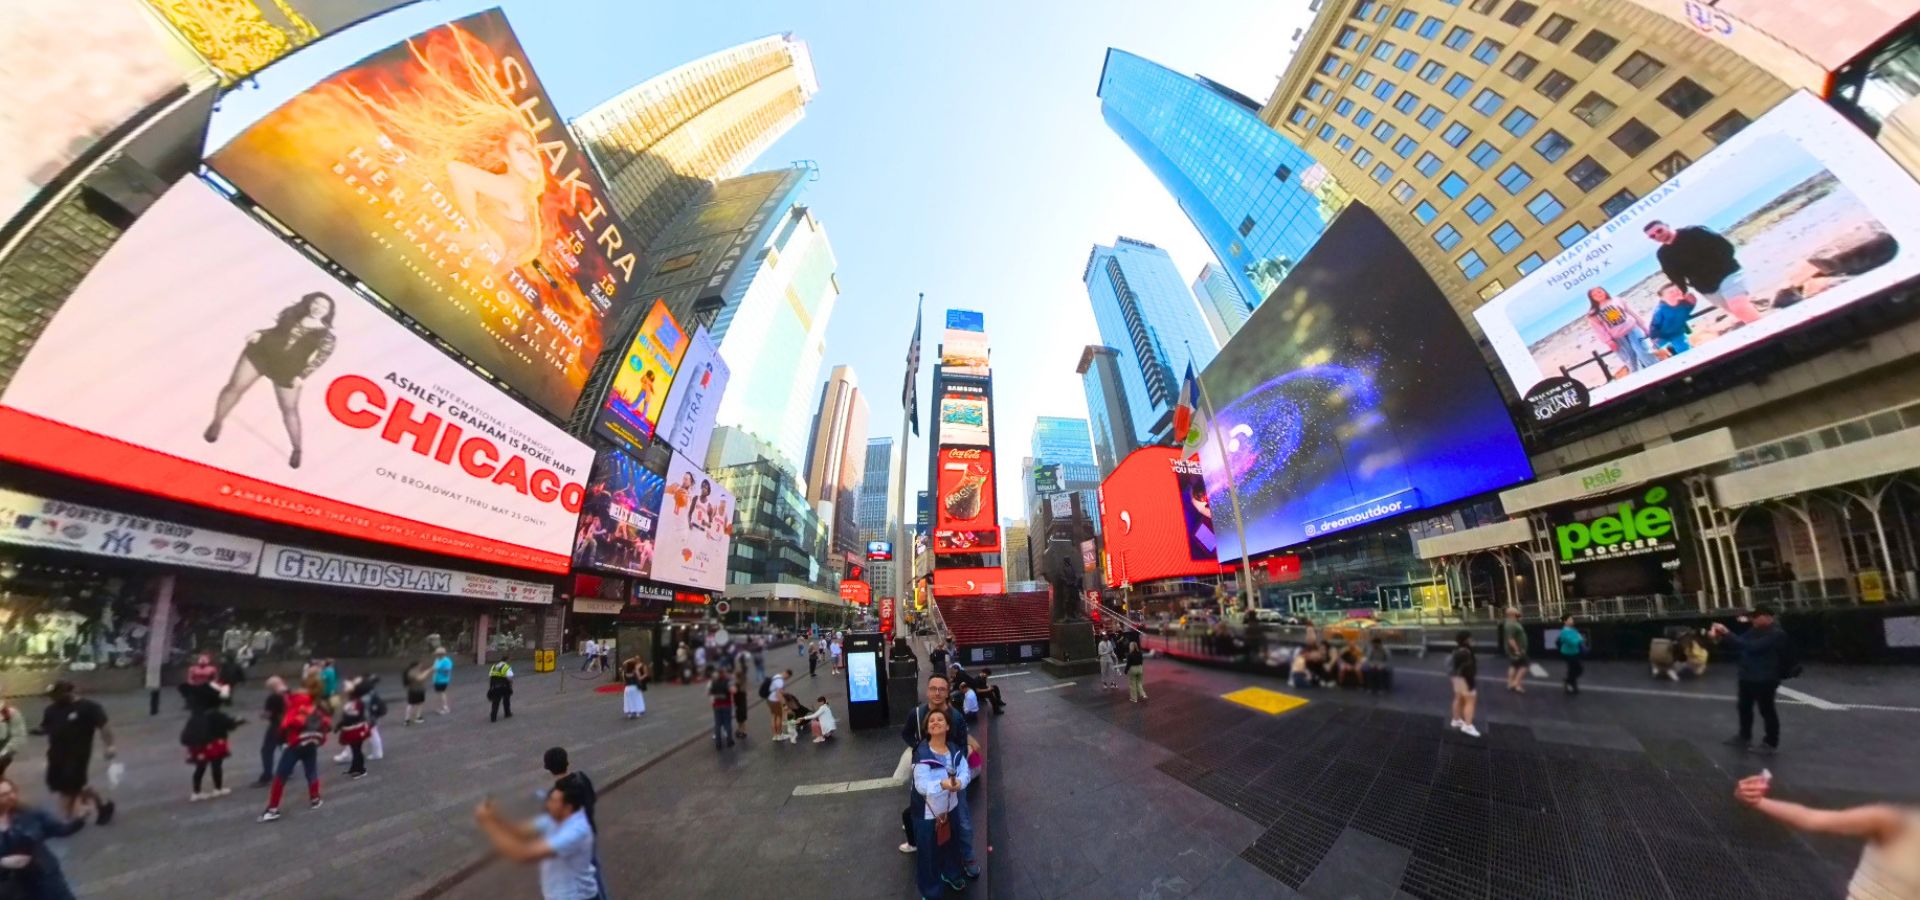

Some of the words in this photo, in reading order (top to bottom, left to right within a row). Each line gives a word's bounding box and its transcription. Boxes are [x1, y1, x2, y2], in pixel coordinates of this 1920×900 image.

[501, 56, 636, 283] SHAKIRA
[1556, 232, 1601, 266] HAPPY
[1605, 179, 1682, 233] BIRTHDAY
[332, 163, 379, 204] BEST
[384, 211, 445, 268] FEMALE
[449, 272, 498, 313] ARTIST
[502, 316, 519, 332] OF
[520, 334, 541, 352] ALL
[544, 352, 568, 374] TIME
[347, 146, 406, 205] HER
[415, 212, 472, 268] HIPS
[481, 275, 545, 335] DON'T
[550, 337, 576, 364] LIE
[422, 177, 469, 230] TOUR
[480, 243, 501, 266] IN
[508, 269, 538, 303] THE
[541, 304, 583, 347] WORLD
[1547, 260, 1583, 287] Happy
[1585, 242, 1613, 262] 40th
[1562, 264, 1600, 291] Daddy
[947, 385, 983, 393] SAMSUNG
[1534, 396, 1581, 420] SQUARE
[325, 373, 587, 514] CHICAGO
[384, 371, 446, 409] ASHLEY
[448, 404, 507, 443] GRAHAM
[508, 435, 519, 450] IS
[521, 442, 552, 466] ROXIE
[552, 458, 576, 477] HART
[432, 383, 506, 429] INTERNATIONAL
[508, 425, 556, 456] SUPERMODEL
[680, 392, 704, 448] ULTRA
[375, 466, 397, 481] ON
[400, 474, 463, 501] BROADWAY
[465, 495, 489, 510] THRU
[491, 504, 509, 516] MAY
[511, 510, 522, 520] 25
[1171, 466, 1187, 474] YOU
[42, 500, 113, 525] SPORTS
[116, 514, 149, 532] FAN
[153, 519, 194, 538] SHOP
[233, 489, 321, 516] AMBASSADOR
[419, 531, 430, 540] AT
[432, 534, 474, 551] BROADWAY
[1556, 486, 1672, 560] pelé
[1584, 537, 1658, 556] SOCCER
[639, 585, 659, 594] BLUE
[661, 587, 673, 596] FIN
